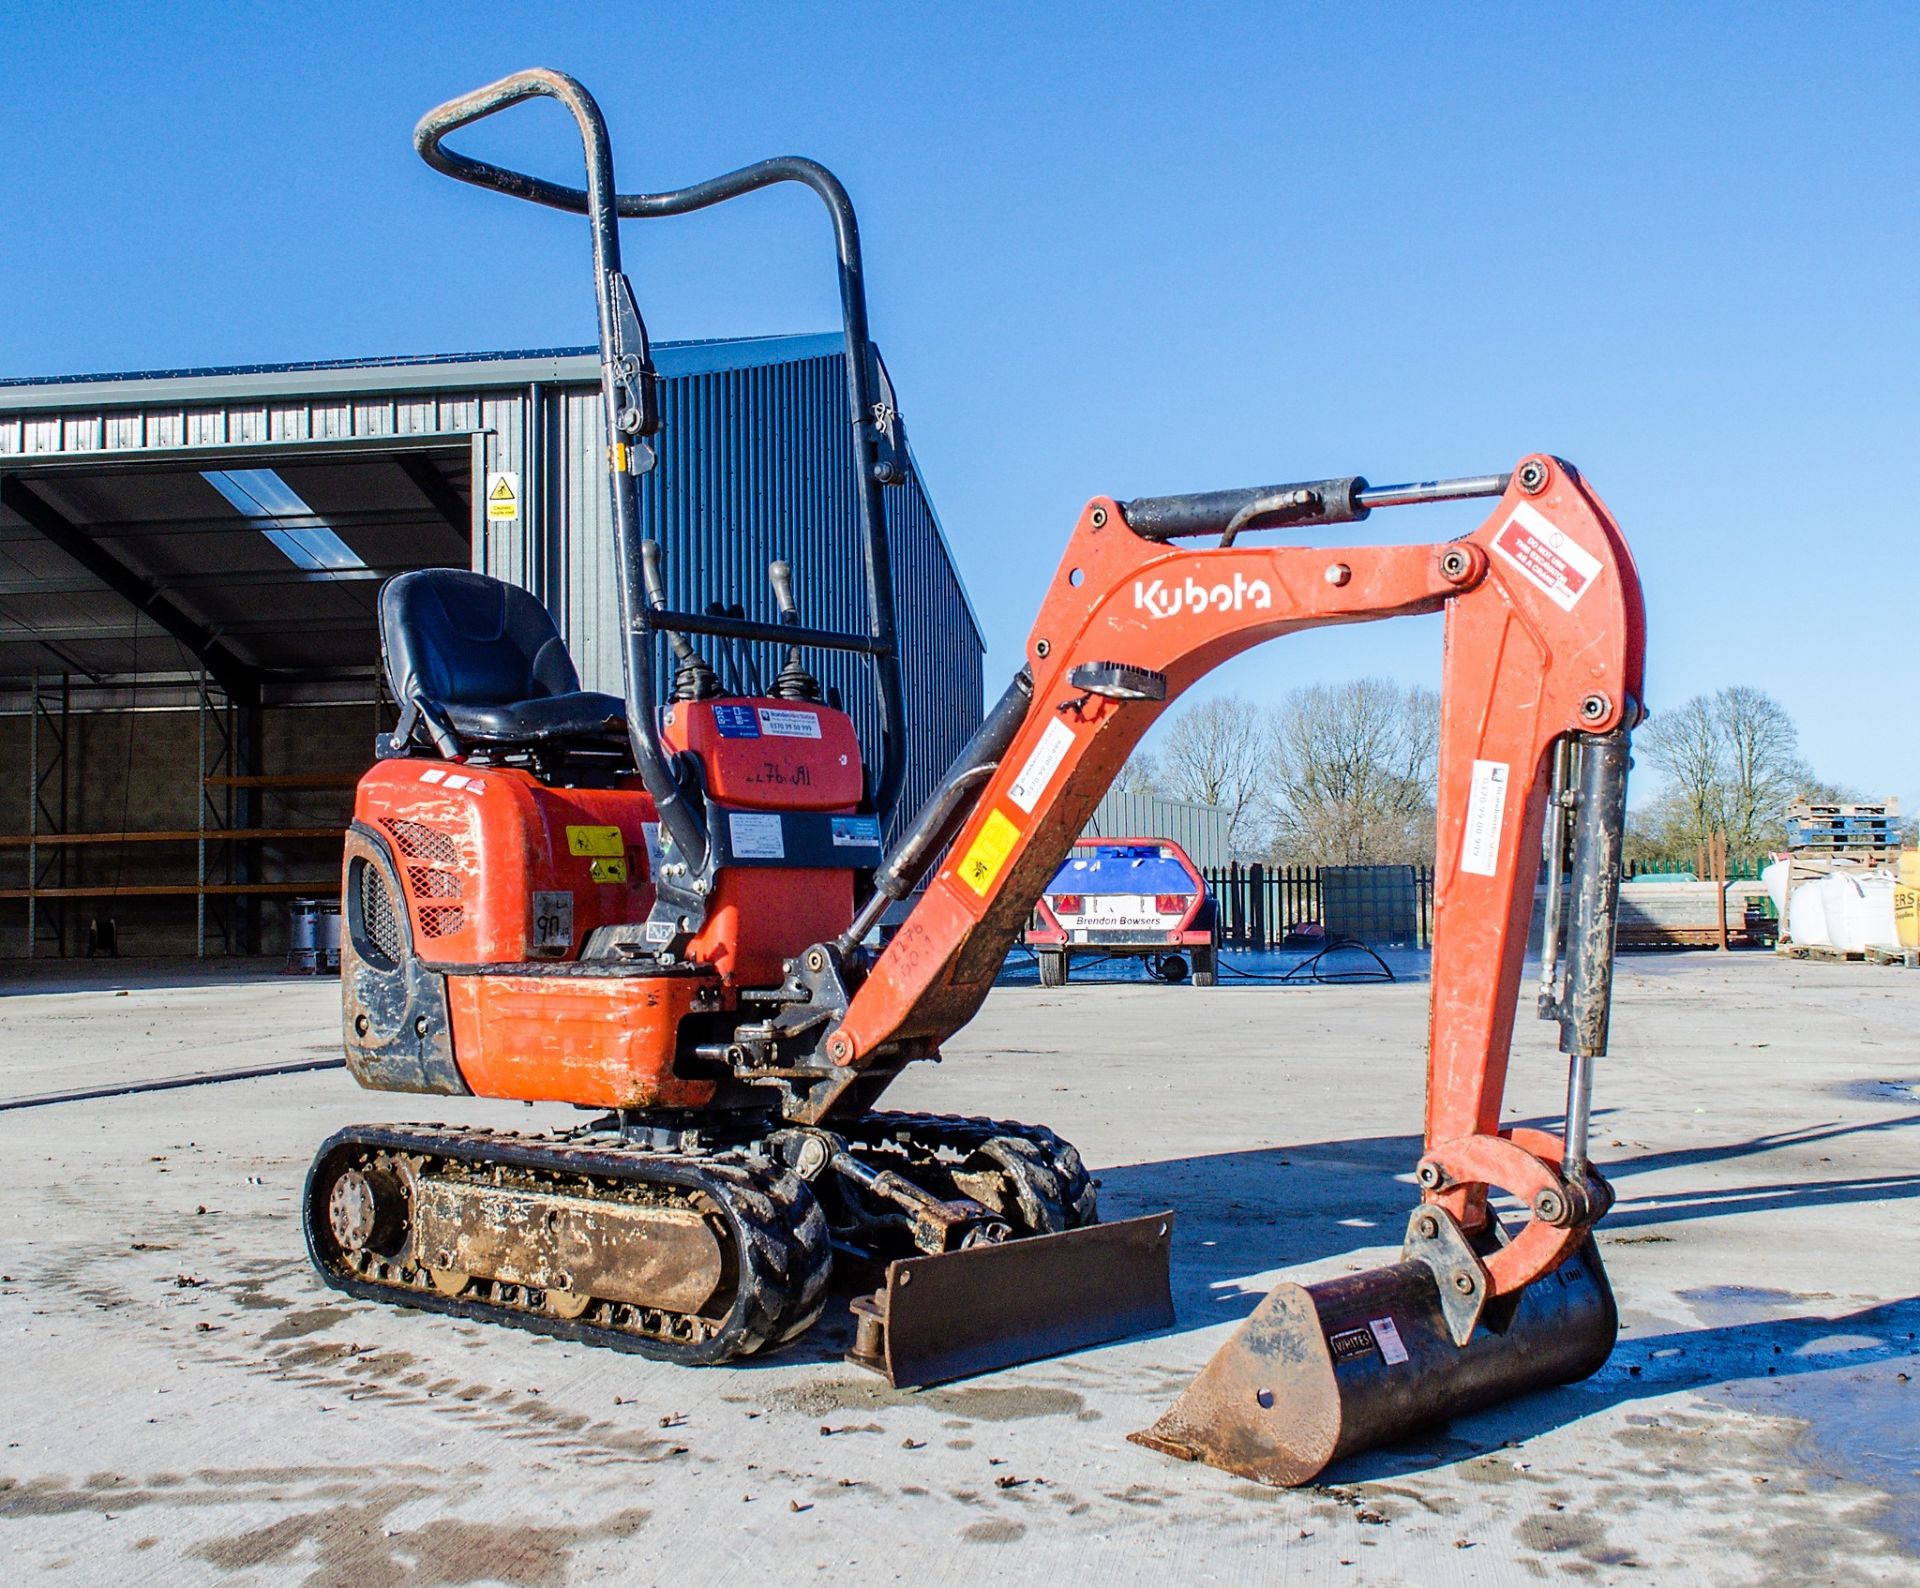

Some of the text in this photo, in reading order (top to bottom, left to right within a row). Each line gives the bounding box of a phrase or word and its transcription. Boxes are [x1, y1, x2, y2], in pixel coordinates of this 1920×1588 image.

[1514, 538, 1568, 584] THIS EXCAVATOR
[1515, 550, 1528, 563] AS
[1530, 563, 1556, 586] CRANE
[1526, 536, 1567, 571] DO NOT USE
[1134, 572, 1272, 618] Kubota
[1076, 916, 1161, 925] Brendon Bowsers
[1335, 1333, 1370, 1352] WHITES
